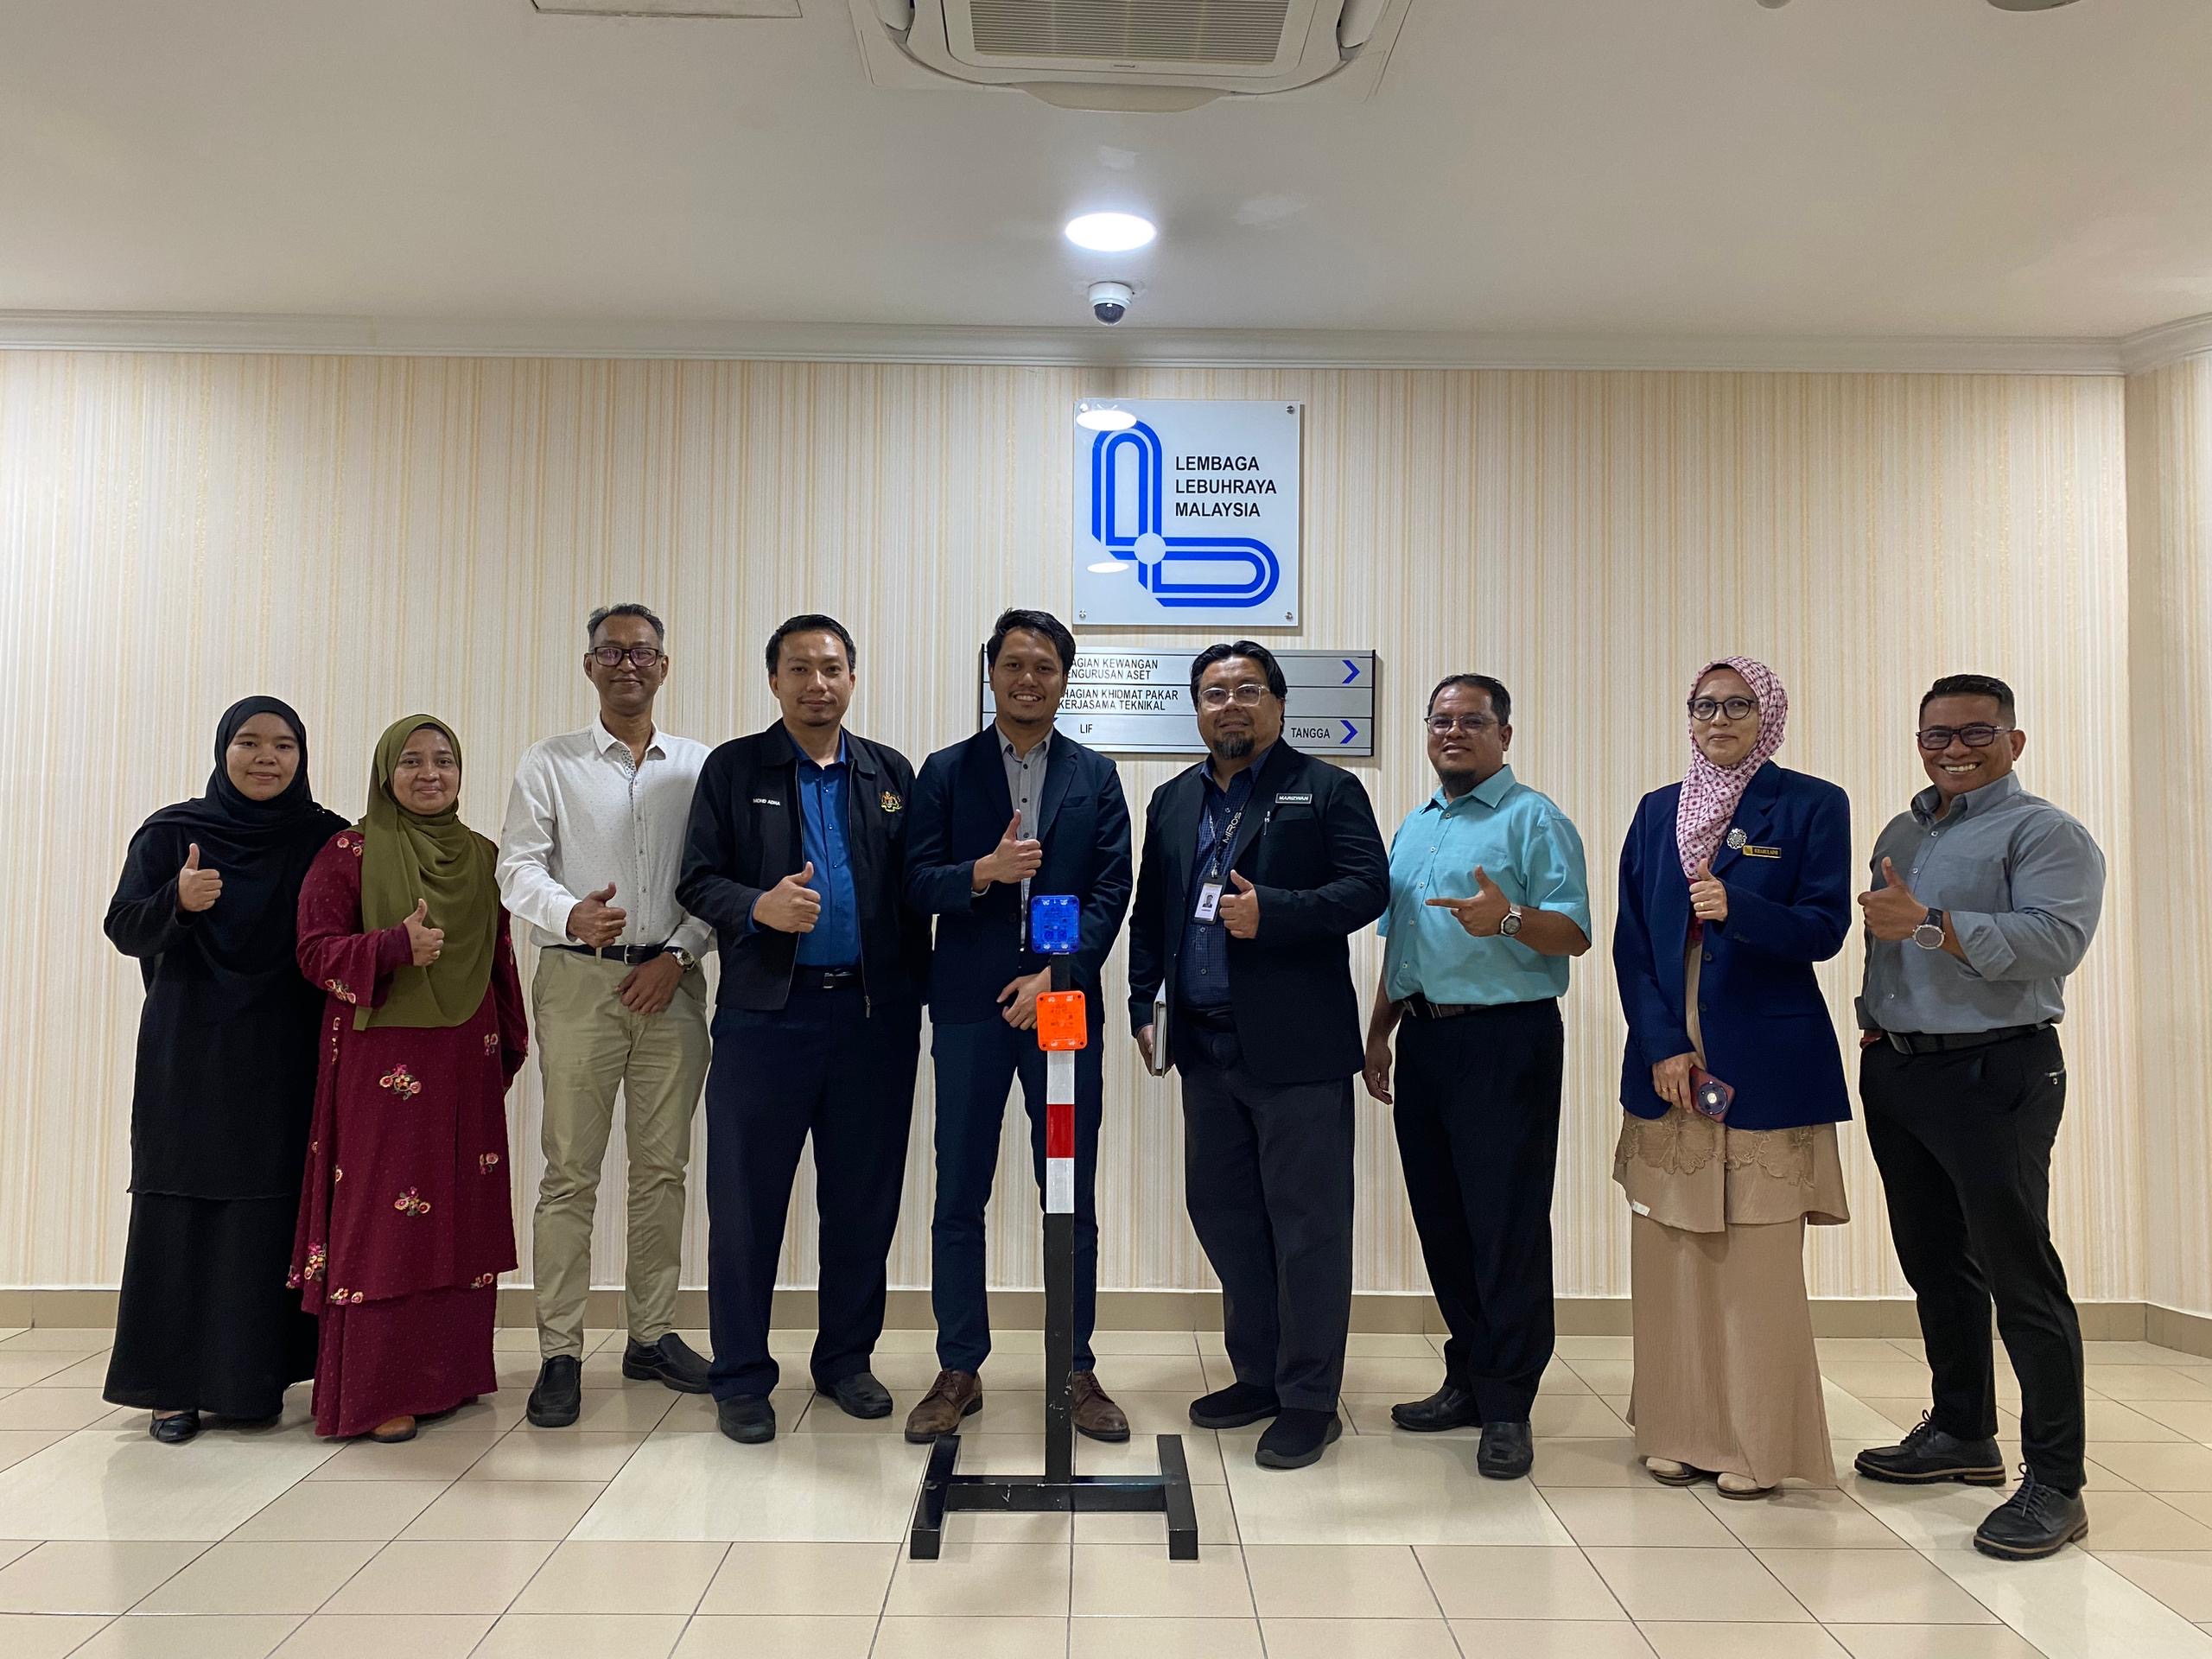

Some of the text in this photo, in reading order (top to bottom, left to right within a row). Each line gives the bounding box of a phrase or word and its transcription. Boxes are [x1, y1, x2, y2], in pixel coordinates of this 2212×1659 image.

[1175, 456, 1260, 471] LEMBAGA
[1175, 480, 1277, 494] LEBUHRAYA
[1175, 502, 1261, 517] MALAYSIA
[1103, 658, 1158, 670] KEWANGAN
[1126, 670, 1151, 680] ASET
[1101, 690, 1142, 700] KHIDMAT
[1145, 690, 1179, 700] PAKAR
[1058, 699, 1166, 711] KERJASAMA TEKNIKAL
[1079, 724, 1093, 734] LIF
[1291, 728, 1331, 739] TANGGA
[1222, 811, 1242, 843] MIROS
